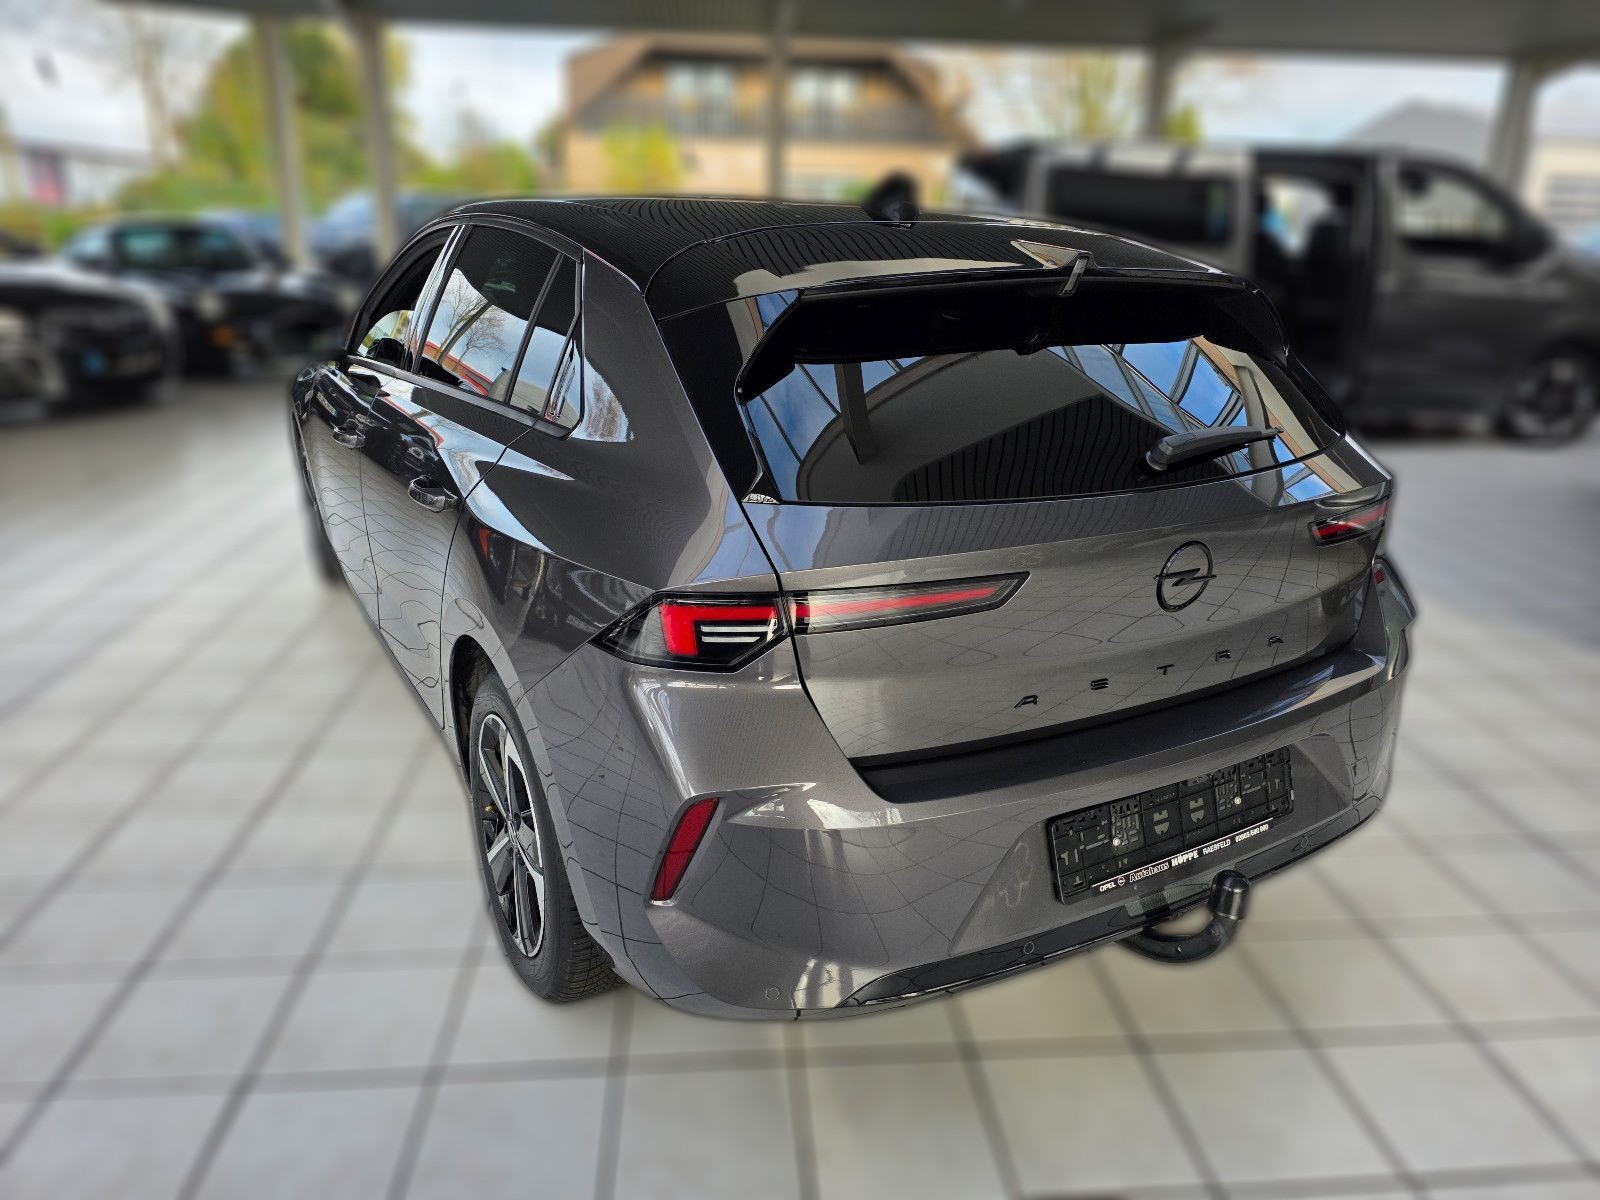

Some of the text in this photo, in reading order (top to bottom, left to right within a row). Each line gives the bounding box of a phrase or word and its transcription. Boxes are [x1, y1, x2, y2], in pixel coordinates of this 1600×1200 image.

[1013, 635, 1284, 709] ASTRA
[1099, 882, 1117, 893] OPEL
[1129, 861, 1170, 883] Autohaus
[1202, 838, 1231, 855] RAESFELD
